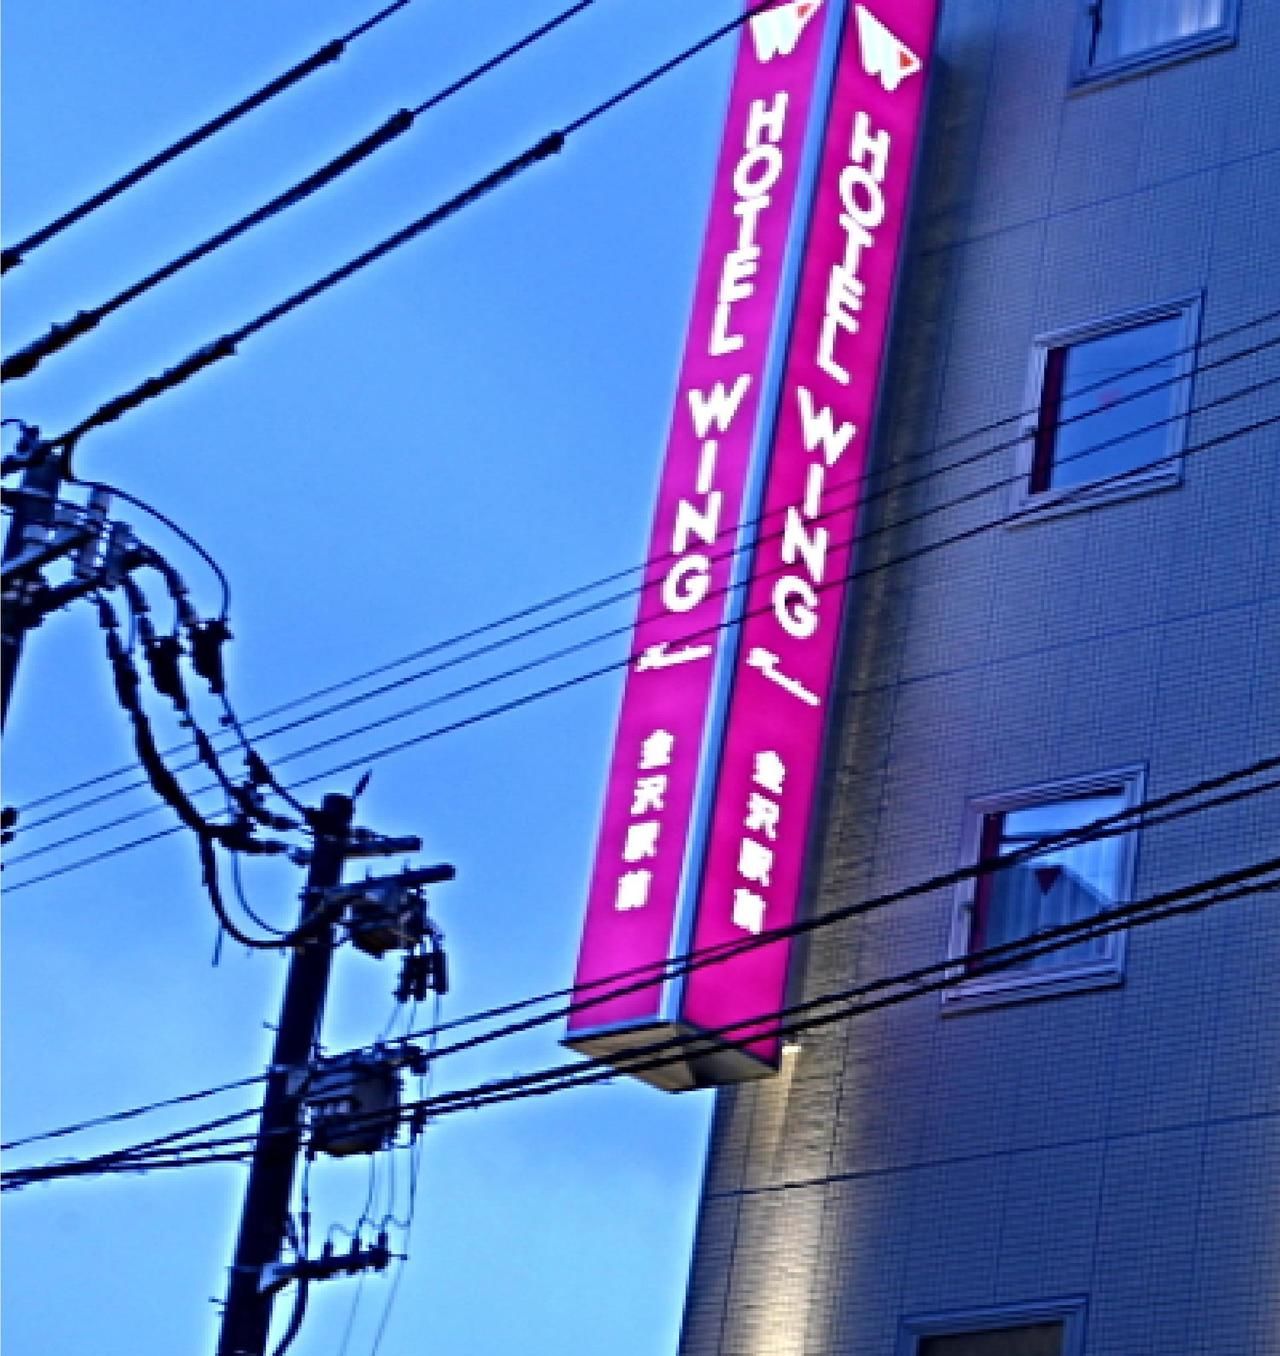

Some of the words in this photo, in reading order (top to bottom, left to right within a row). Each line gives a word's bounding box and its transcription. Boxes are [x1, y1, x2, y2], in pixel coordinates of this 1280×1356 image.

[709, 91, 788, 356] HOTEL
[816, 111, 890, 384] HOTEL
[662, 373, 751, 613] WING
[772, 386, 856, 638] WING
